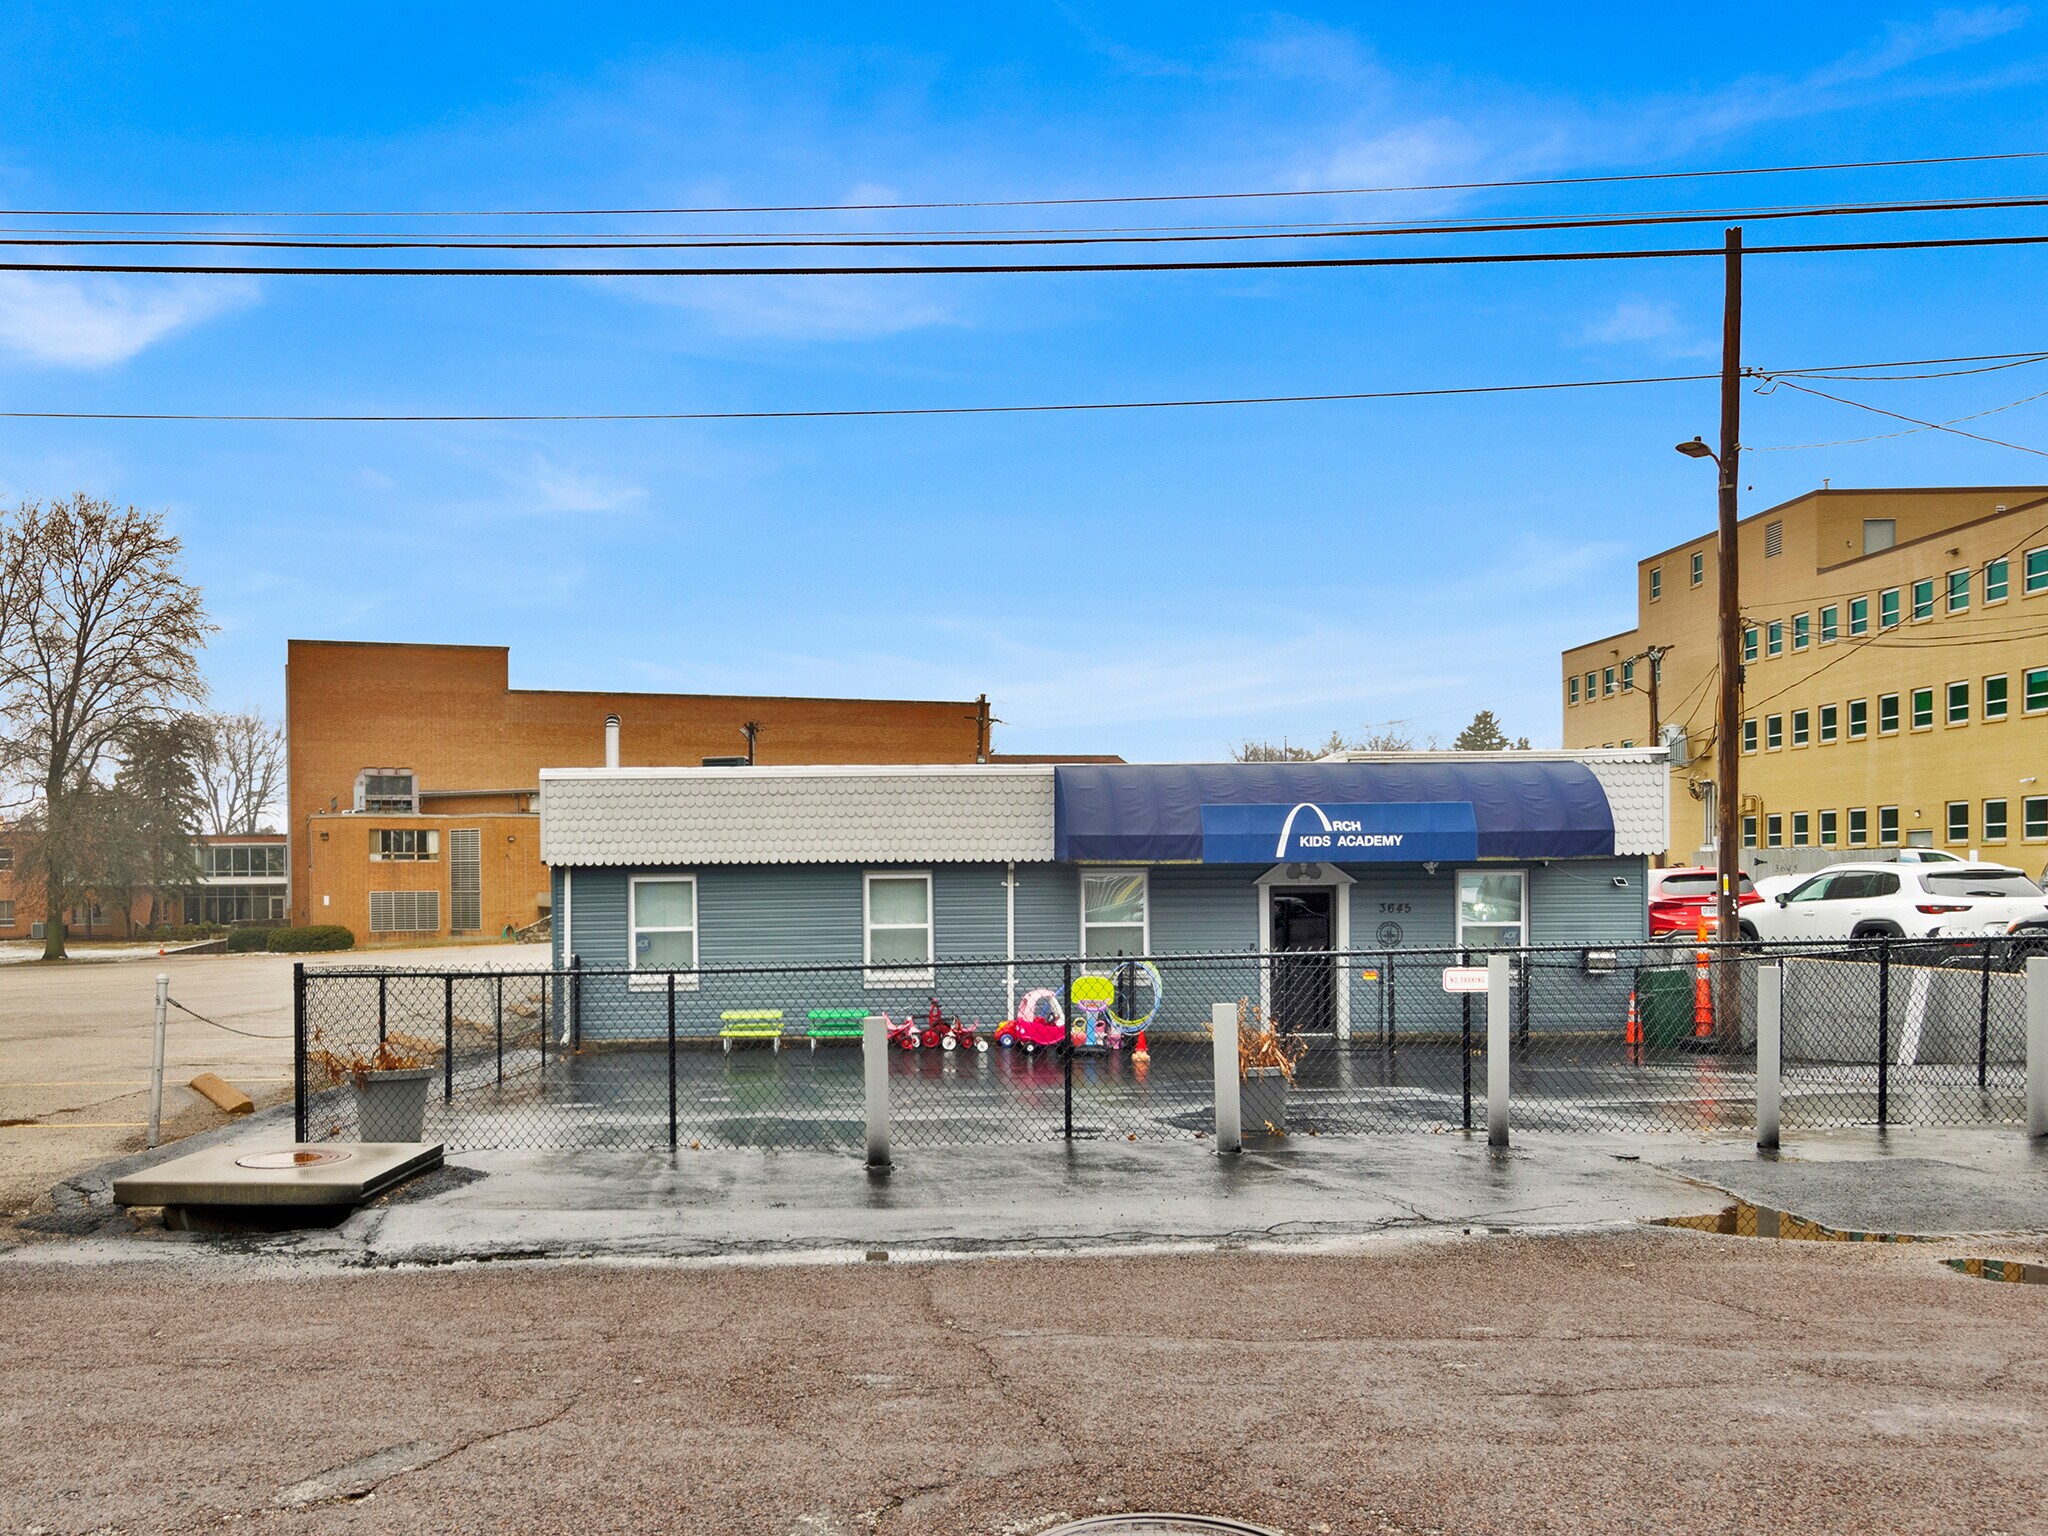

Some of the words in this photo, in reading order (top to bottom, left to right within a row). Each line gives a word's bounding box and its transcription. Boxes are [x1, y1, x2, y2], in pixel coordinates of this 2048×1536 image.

[1300, 836, 1331, 847] KIDS
[1337, 835, 1403, 847] ACADEMY
[1775, 864, 1798, 873] 3645
[1379, 903, 1411, 914] 3645
[1503, 931, 1517, 939] ADT
